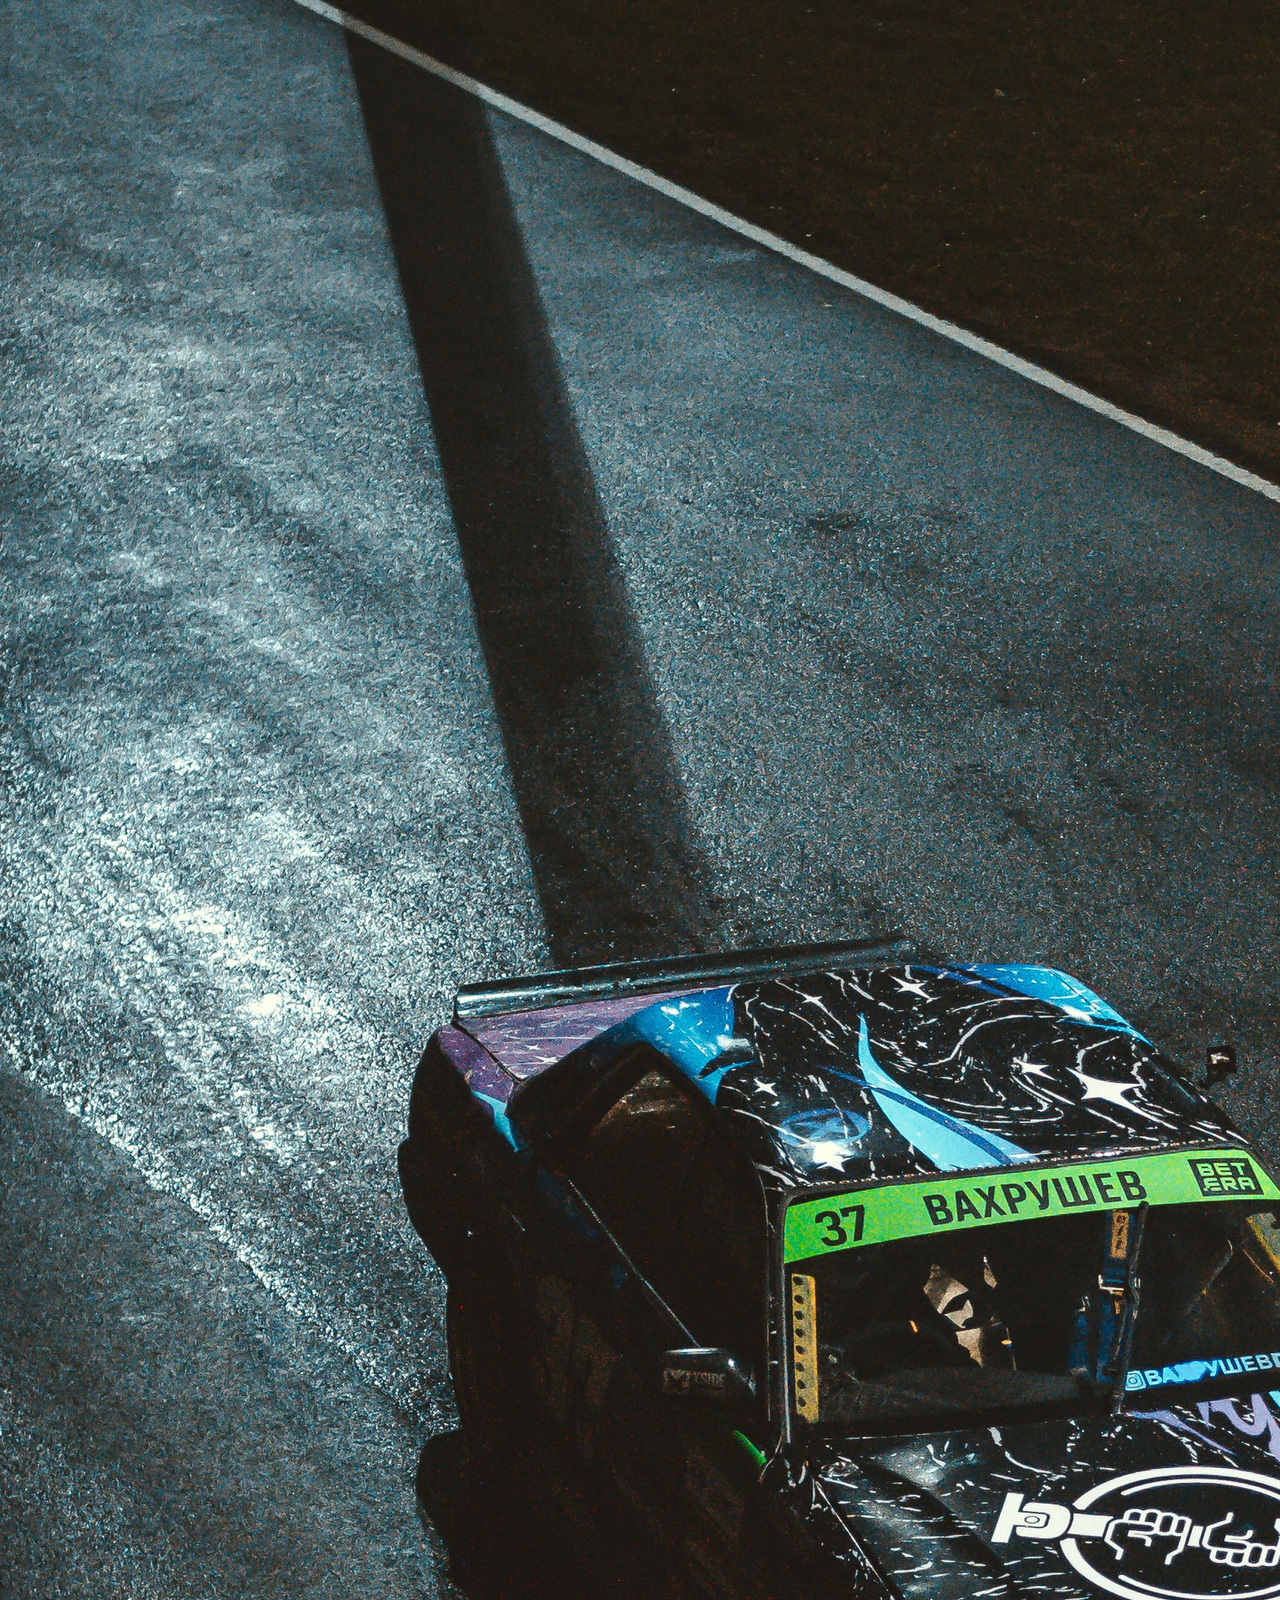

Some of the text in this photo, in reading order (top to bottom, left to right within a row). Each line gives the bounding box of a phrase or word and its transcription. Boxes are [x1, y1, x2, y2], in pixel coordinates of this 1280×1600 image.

[1195, 1162, 1246, 1177] BET
[1203, 1176, 1257, 1192] ERA
[814, 1170, 1148, 1247] 37 ВАХРУШЕВ
